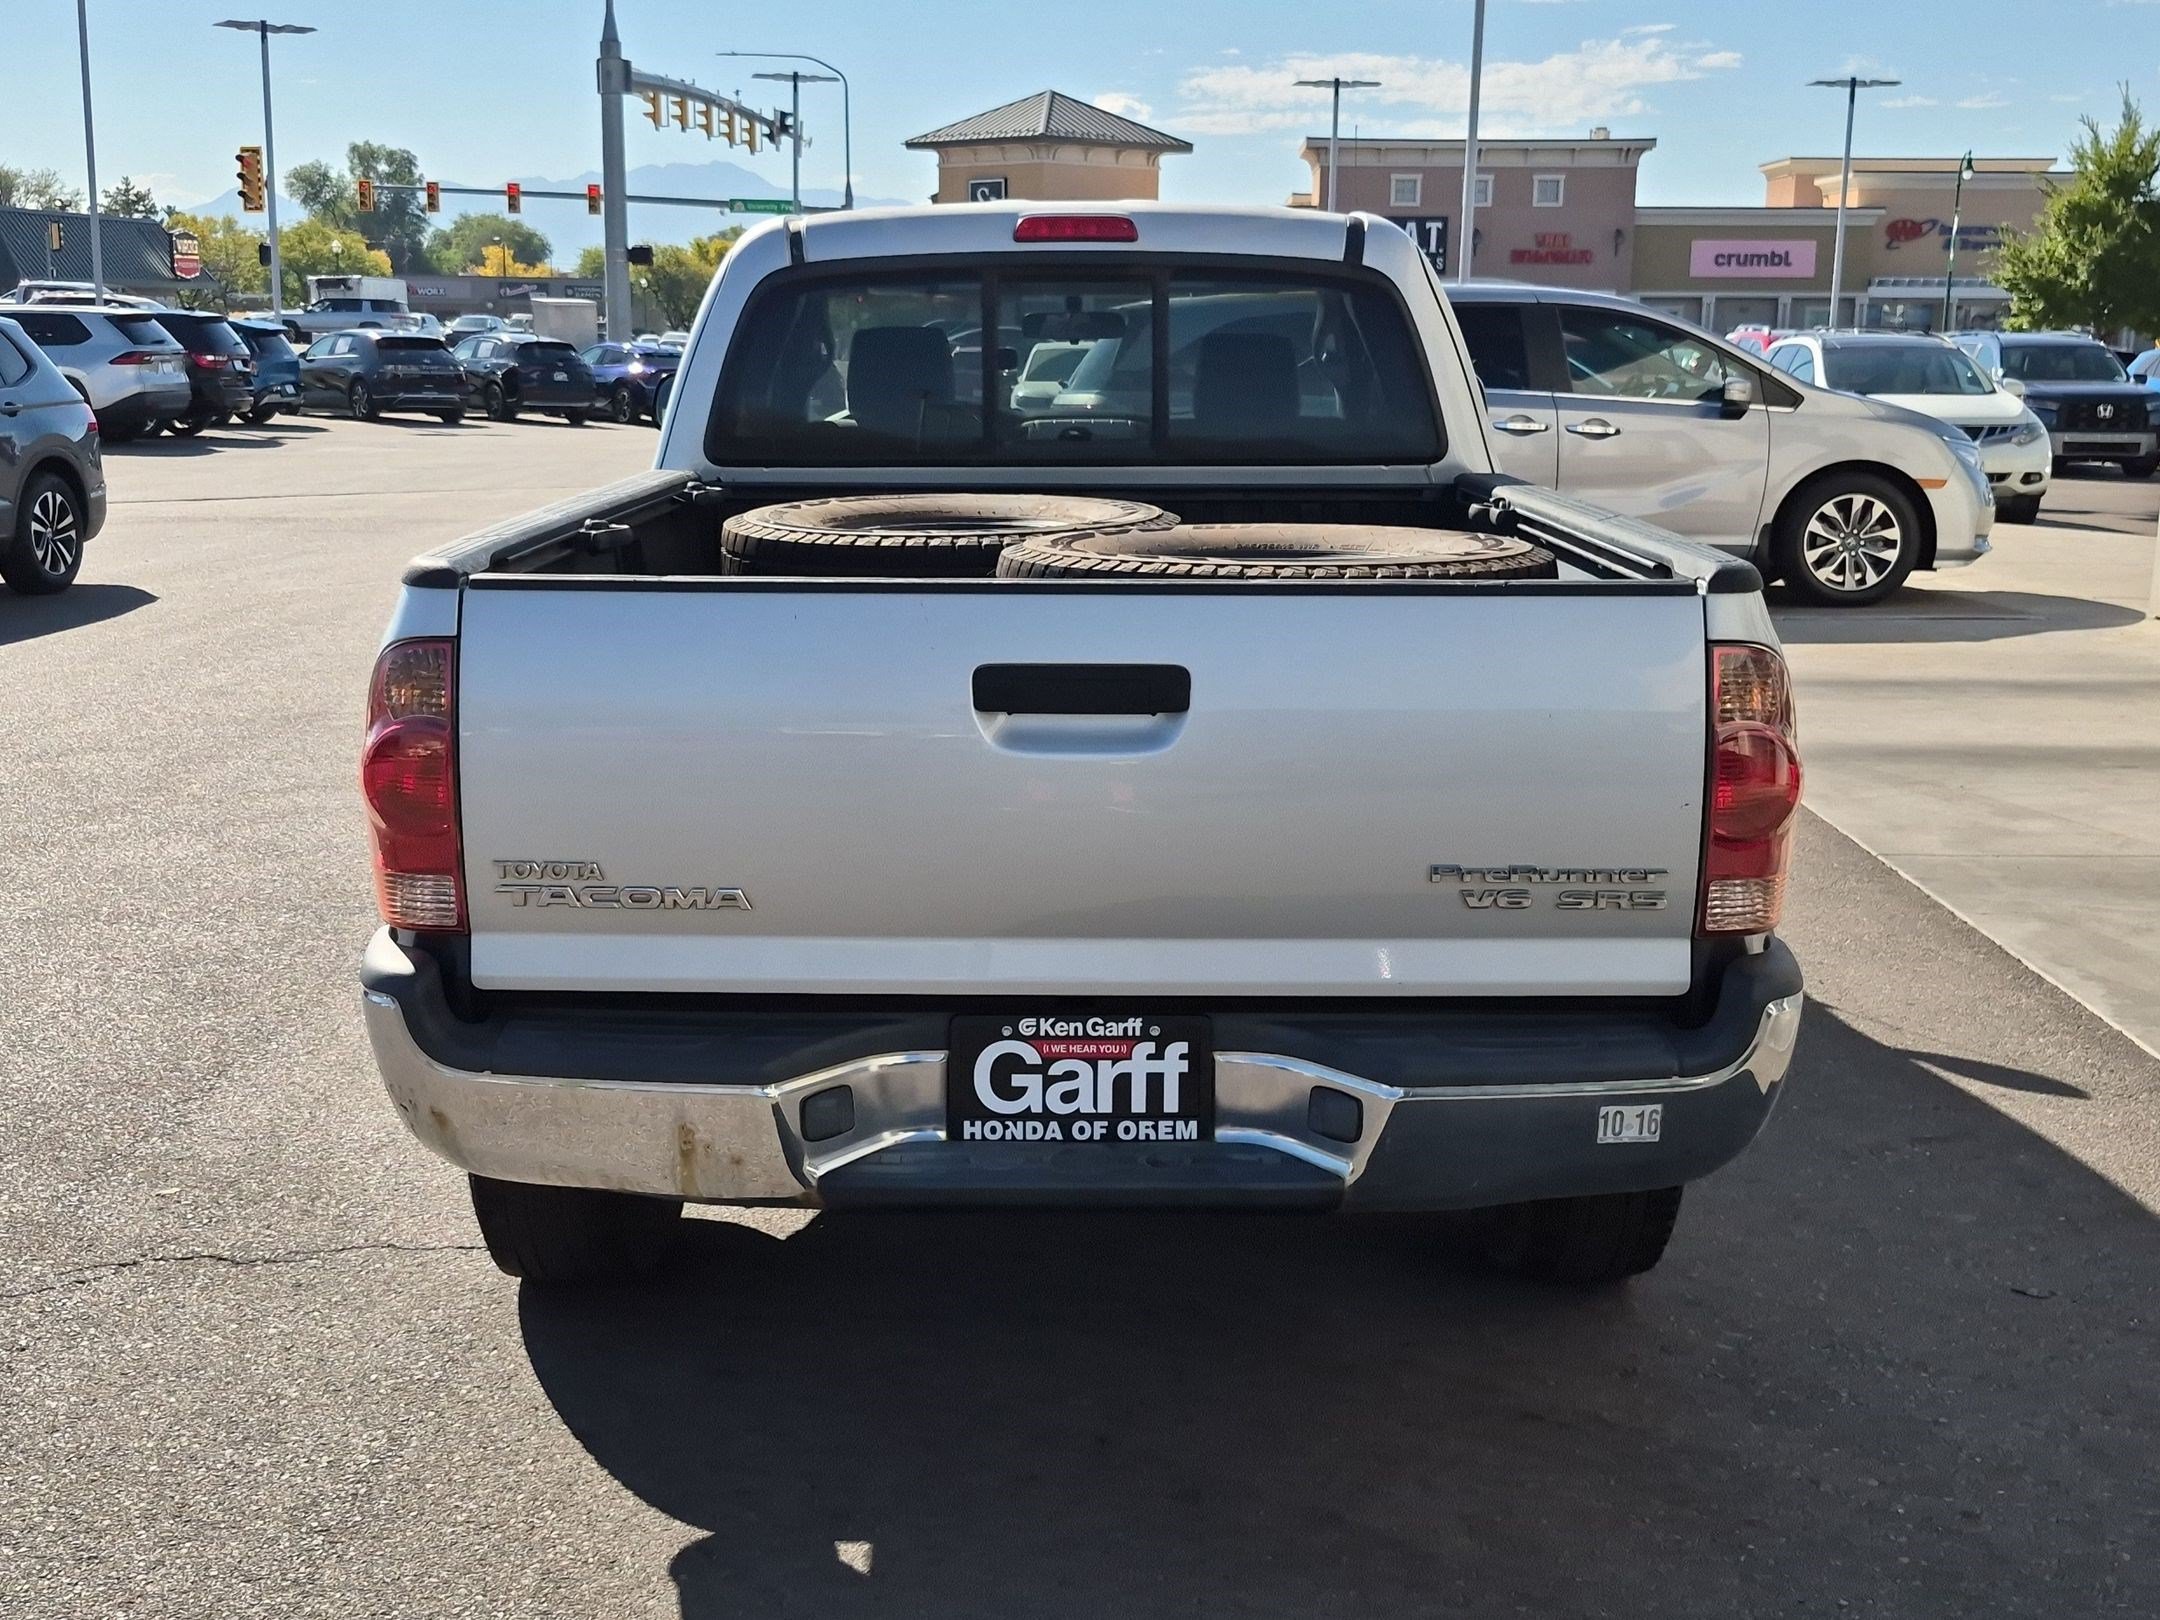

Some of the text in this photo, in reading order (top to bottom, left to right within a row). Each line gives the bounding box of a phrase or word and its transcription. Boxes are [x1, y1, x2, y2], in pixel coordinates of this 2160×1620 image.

[1714, 250, 1792, 267] crumbl
[493, 860, 604, 881] TOYOTA
[1430, 864, 1669, 883] PreRunner
[495, 884, 752, 910] TACOMA
[1461, 889, 1667, 910] V6 SR5
[1040, 1017, 1143, 1037] Ken Garff
[1051, 1044, 1120, 1054] WE HEAR YOU
[973, 1040, 1189, 1115] Garff
[963, 1120, 1198, 1141] HONDA OF OREM
[1600, 1109, 1660, 1137] 10 16
